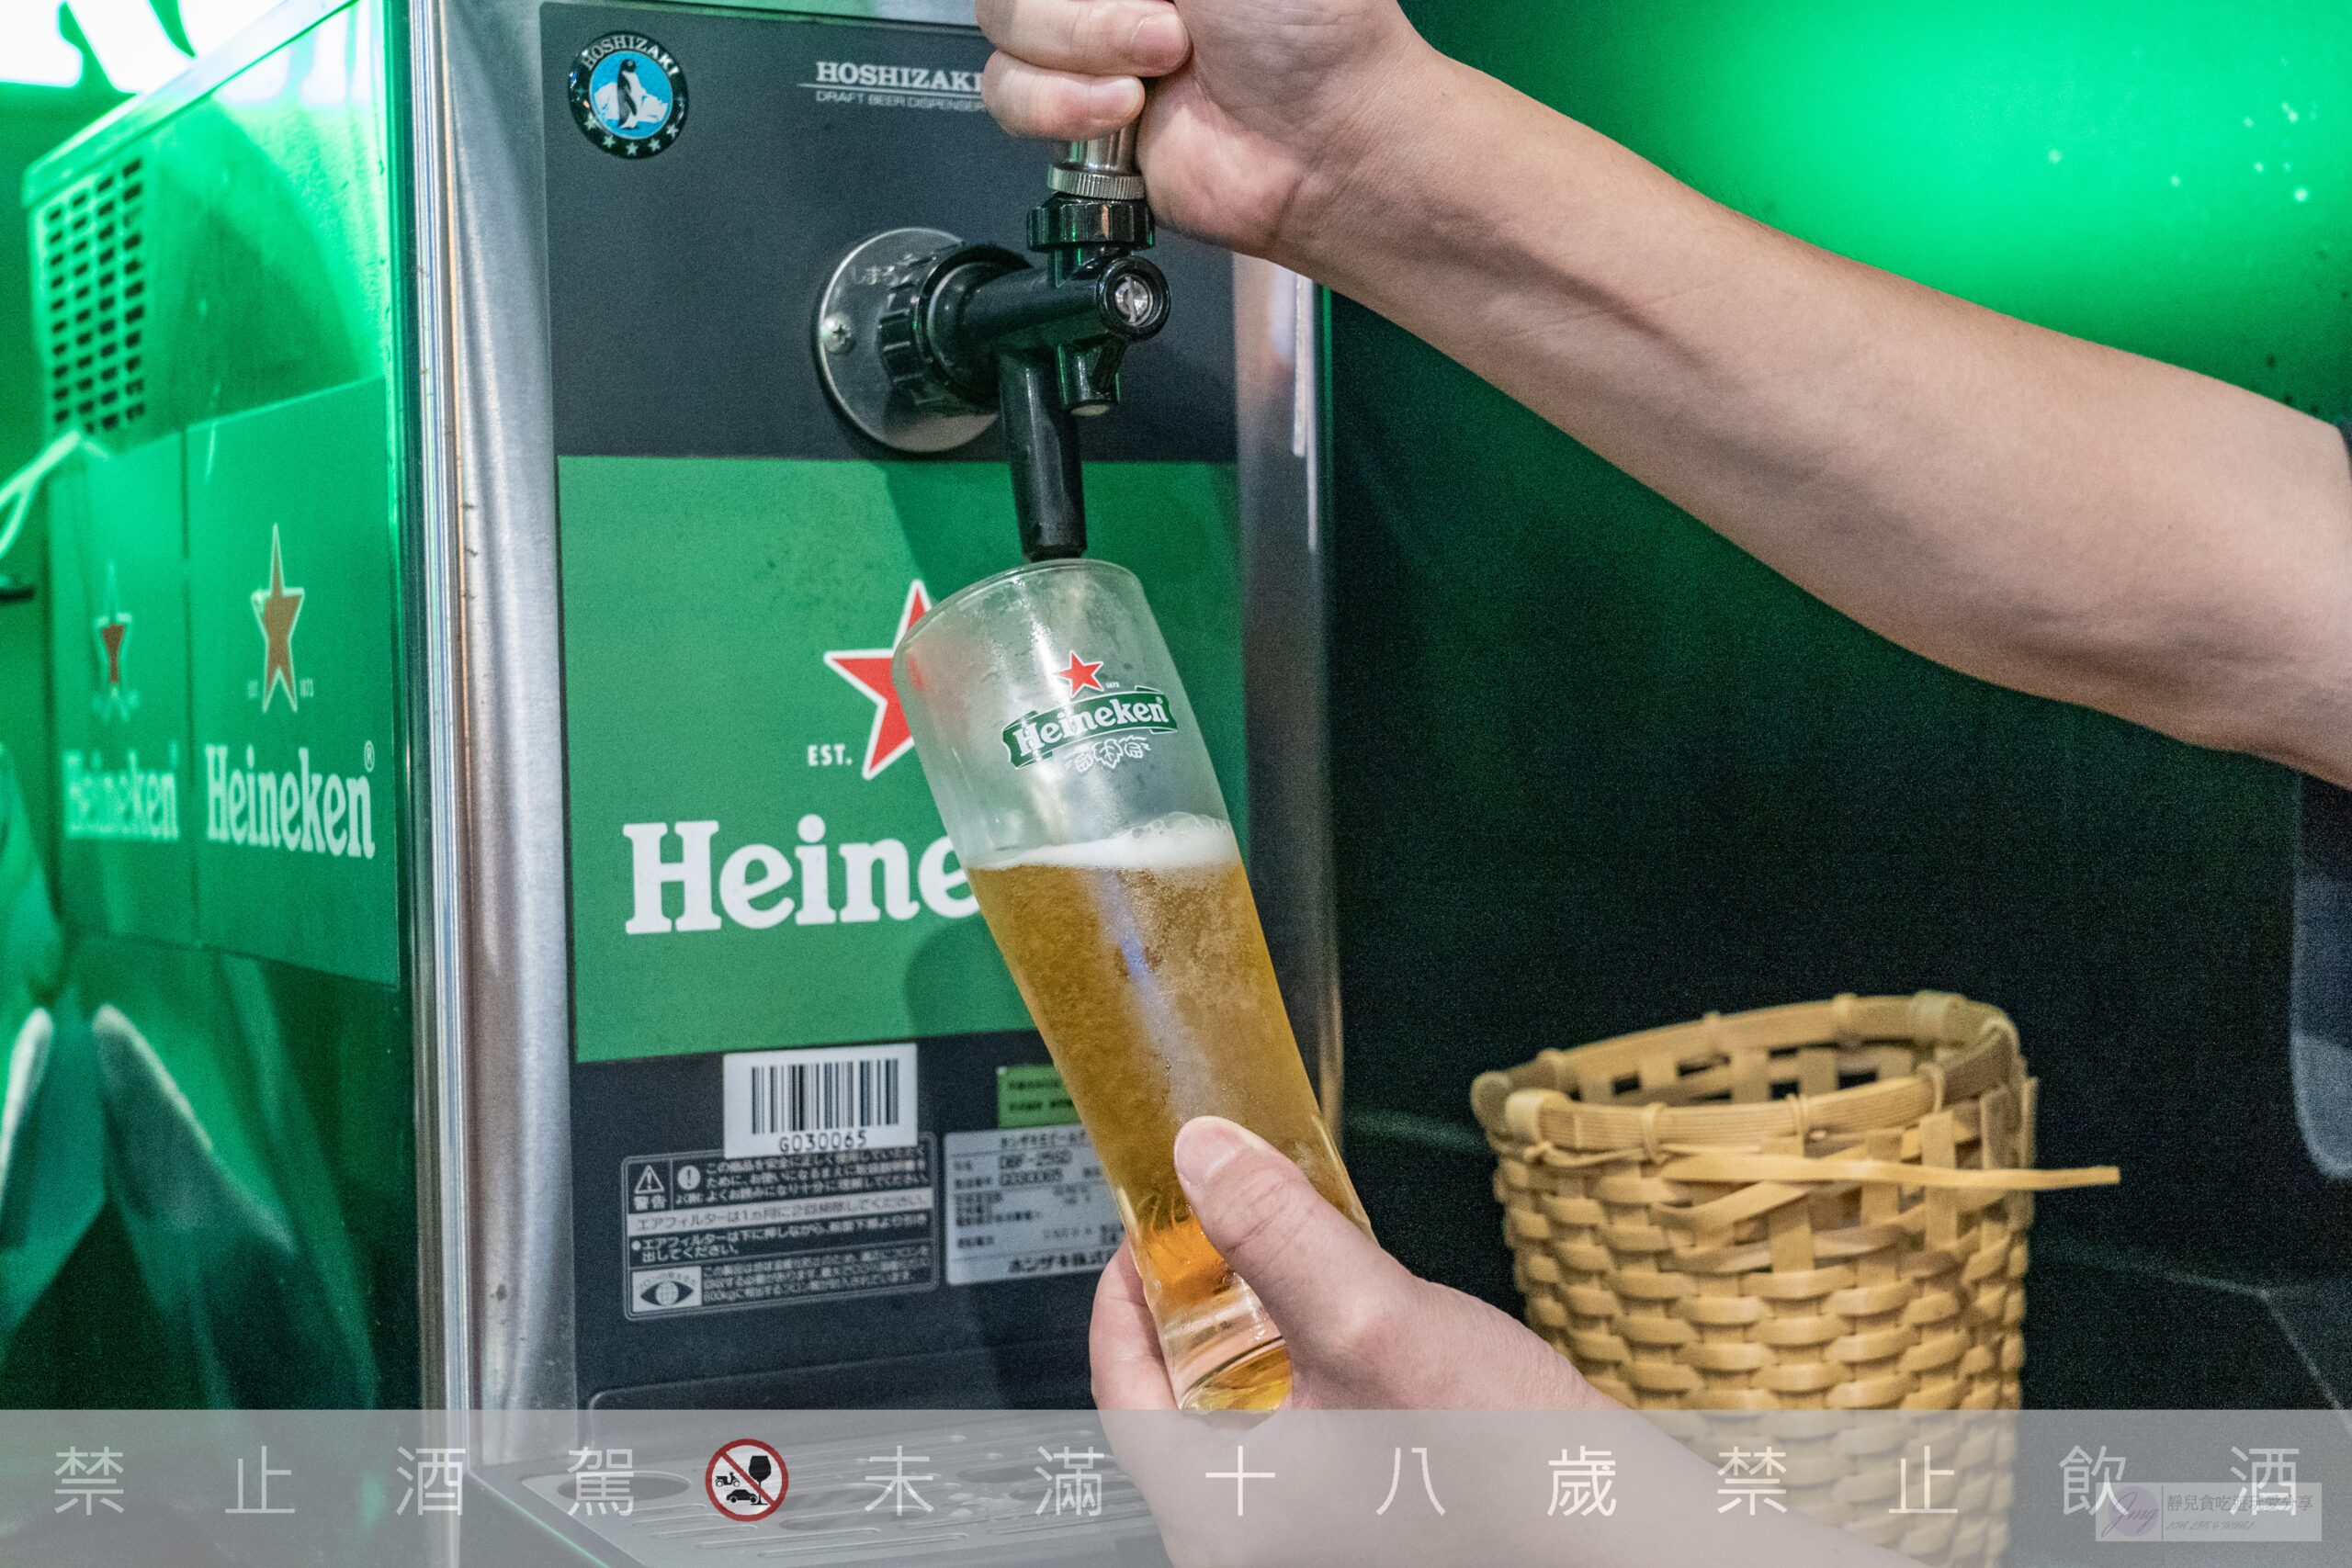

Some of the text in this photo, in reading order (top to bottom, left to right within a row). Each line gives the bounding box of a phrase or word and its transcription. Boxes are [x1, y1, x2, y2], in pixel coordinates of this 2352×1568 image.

[581, 35, 680, 76] HOSHIZAKI
[816, 61, 981, 93] HOSHIZAKI
[816, 90, 863, 105] DRAFT
[1012, 696, 1170, 757] Heineken
[808, 743, 853, 766] EST.
[204, 742, 376, 859] Heineken
[779, 1130, 867, 1153] G030065
